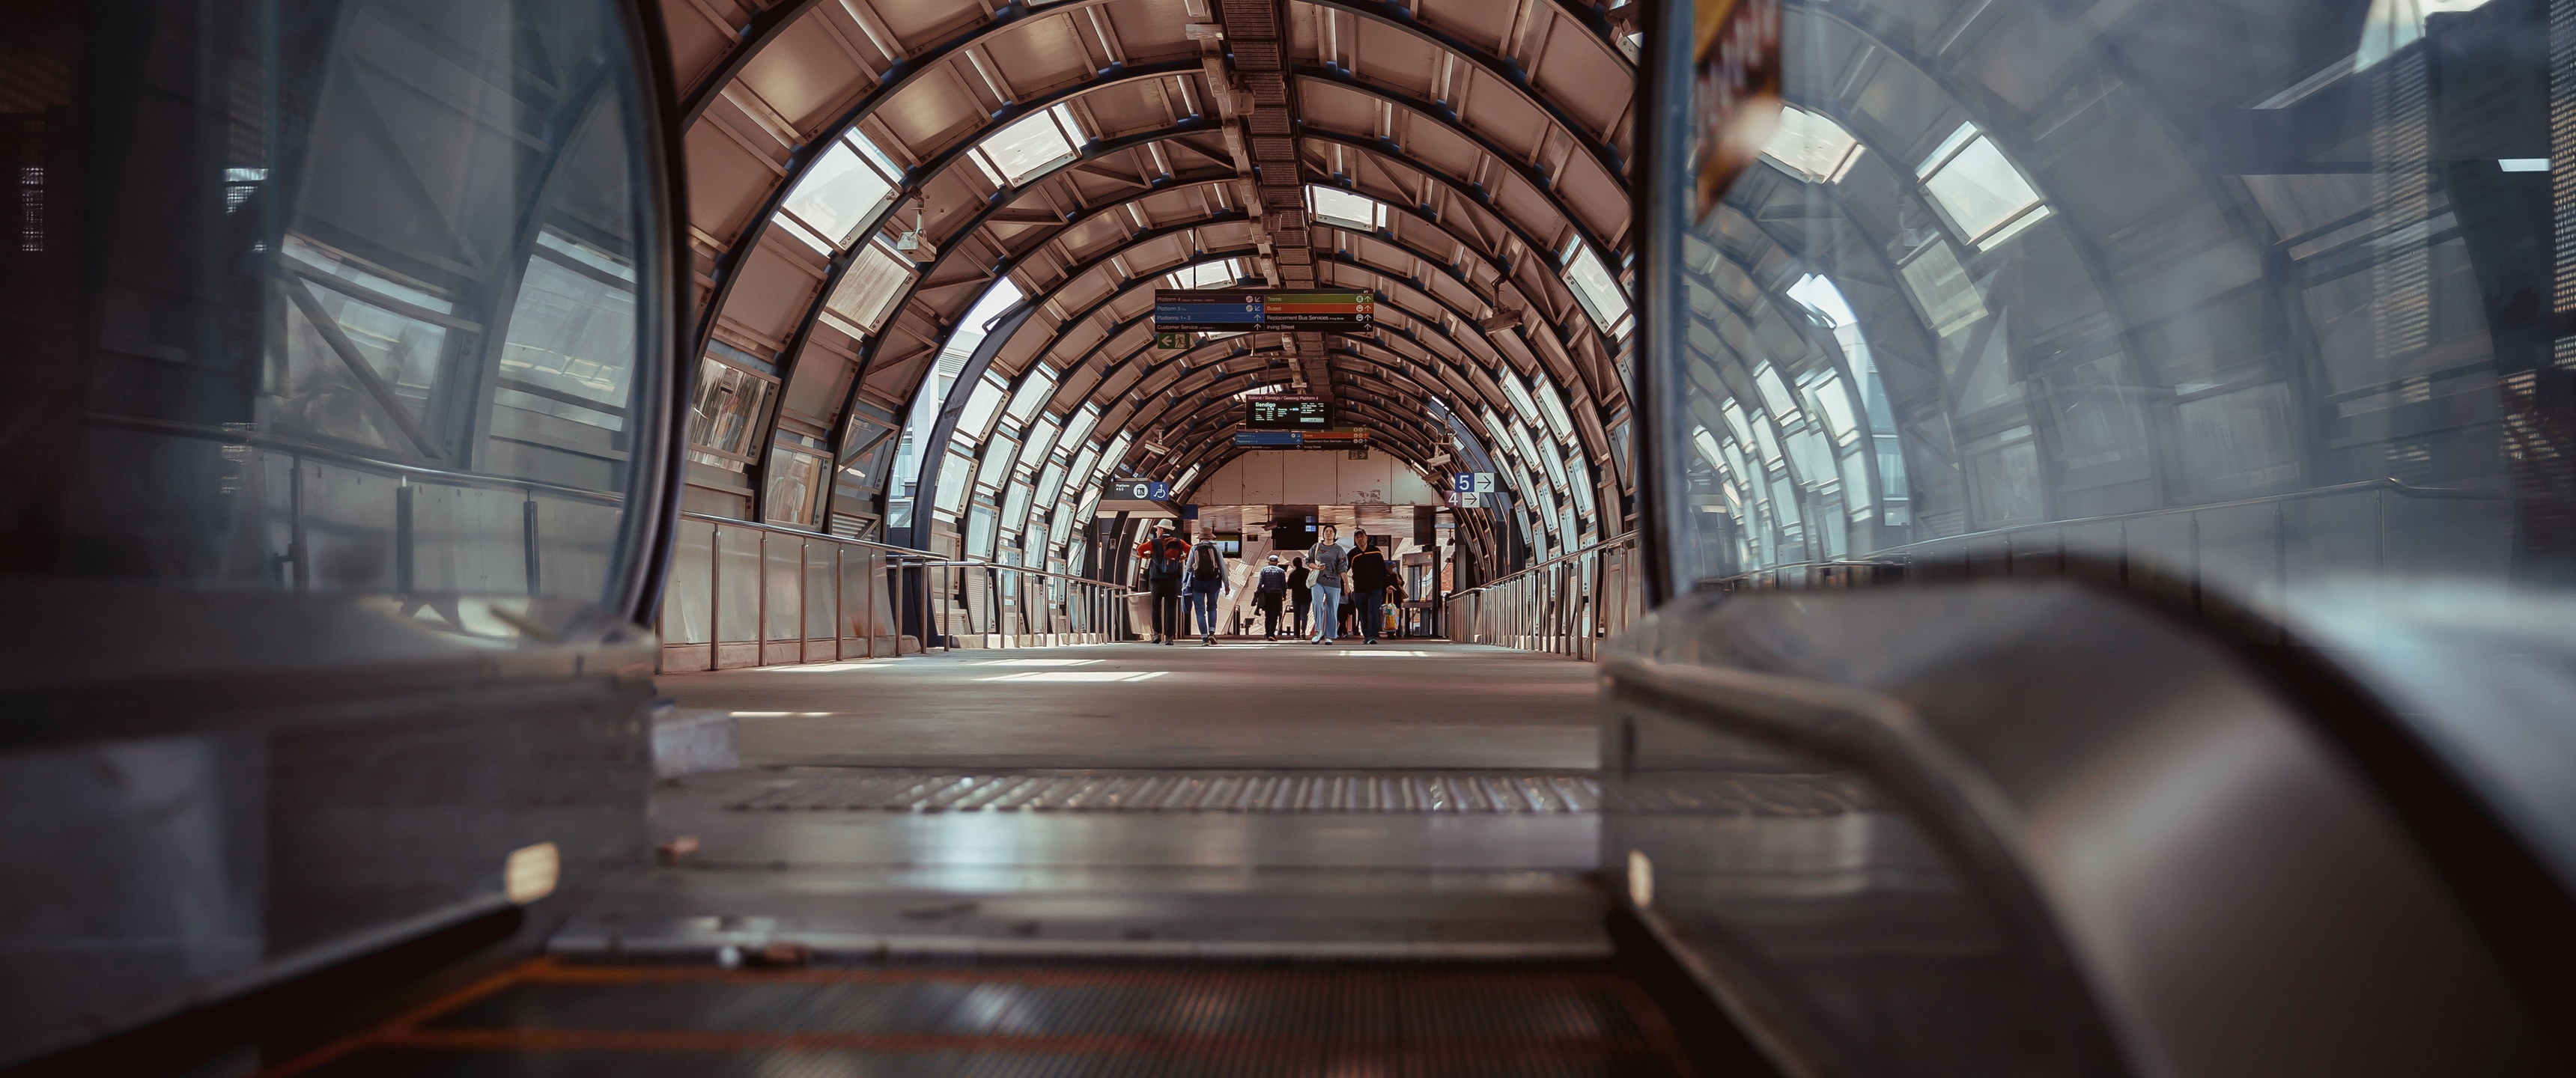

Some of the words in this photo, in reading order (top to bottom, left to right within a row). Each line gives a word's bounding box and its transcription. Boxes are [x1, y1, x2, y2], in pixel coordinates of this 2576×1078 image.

[1459, 475, 1469, 490] 5
[1448, 493, 1458, 505] 4
[1368, 536, 1374, 545] 2
